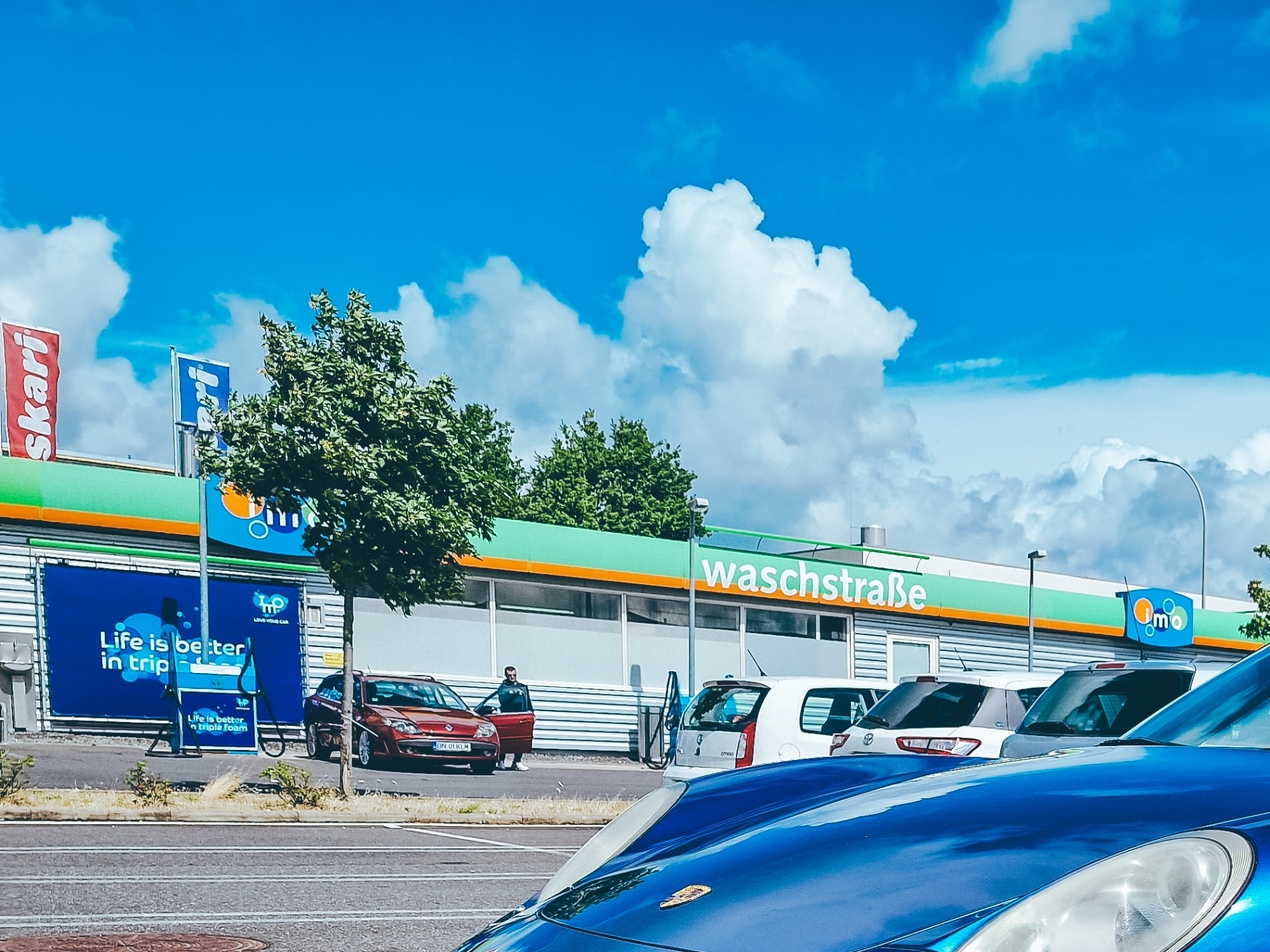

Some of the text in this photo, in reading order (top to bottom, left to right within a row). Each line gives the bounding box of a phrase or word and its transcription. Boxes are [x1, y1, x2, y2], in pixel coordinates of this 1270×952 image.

[701, 558, 927, 611] waschstraße
[1144, 606, 1183, 631] imo
[100, 631, 143, 651] Life
[149, 633, 169, 652] is
[101, 651, 123, 670] in
[187, 714, 245, 724] Life is better
[198, 723, 222, 732] triple
[224, 723, 248, 732] foam
